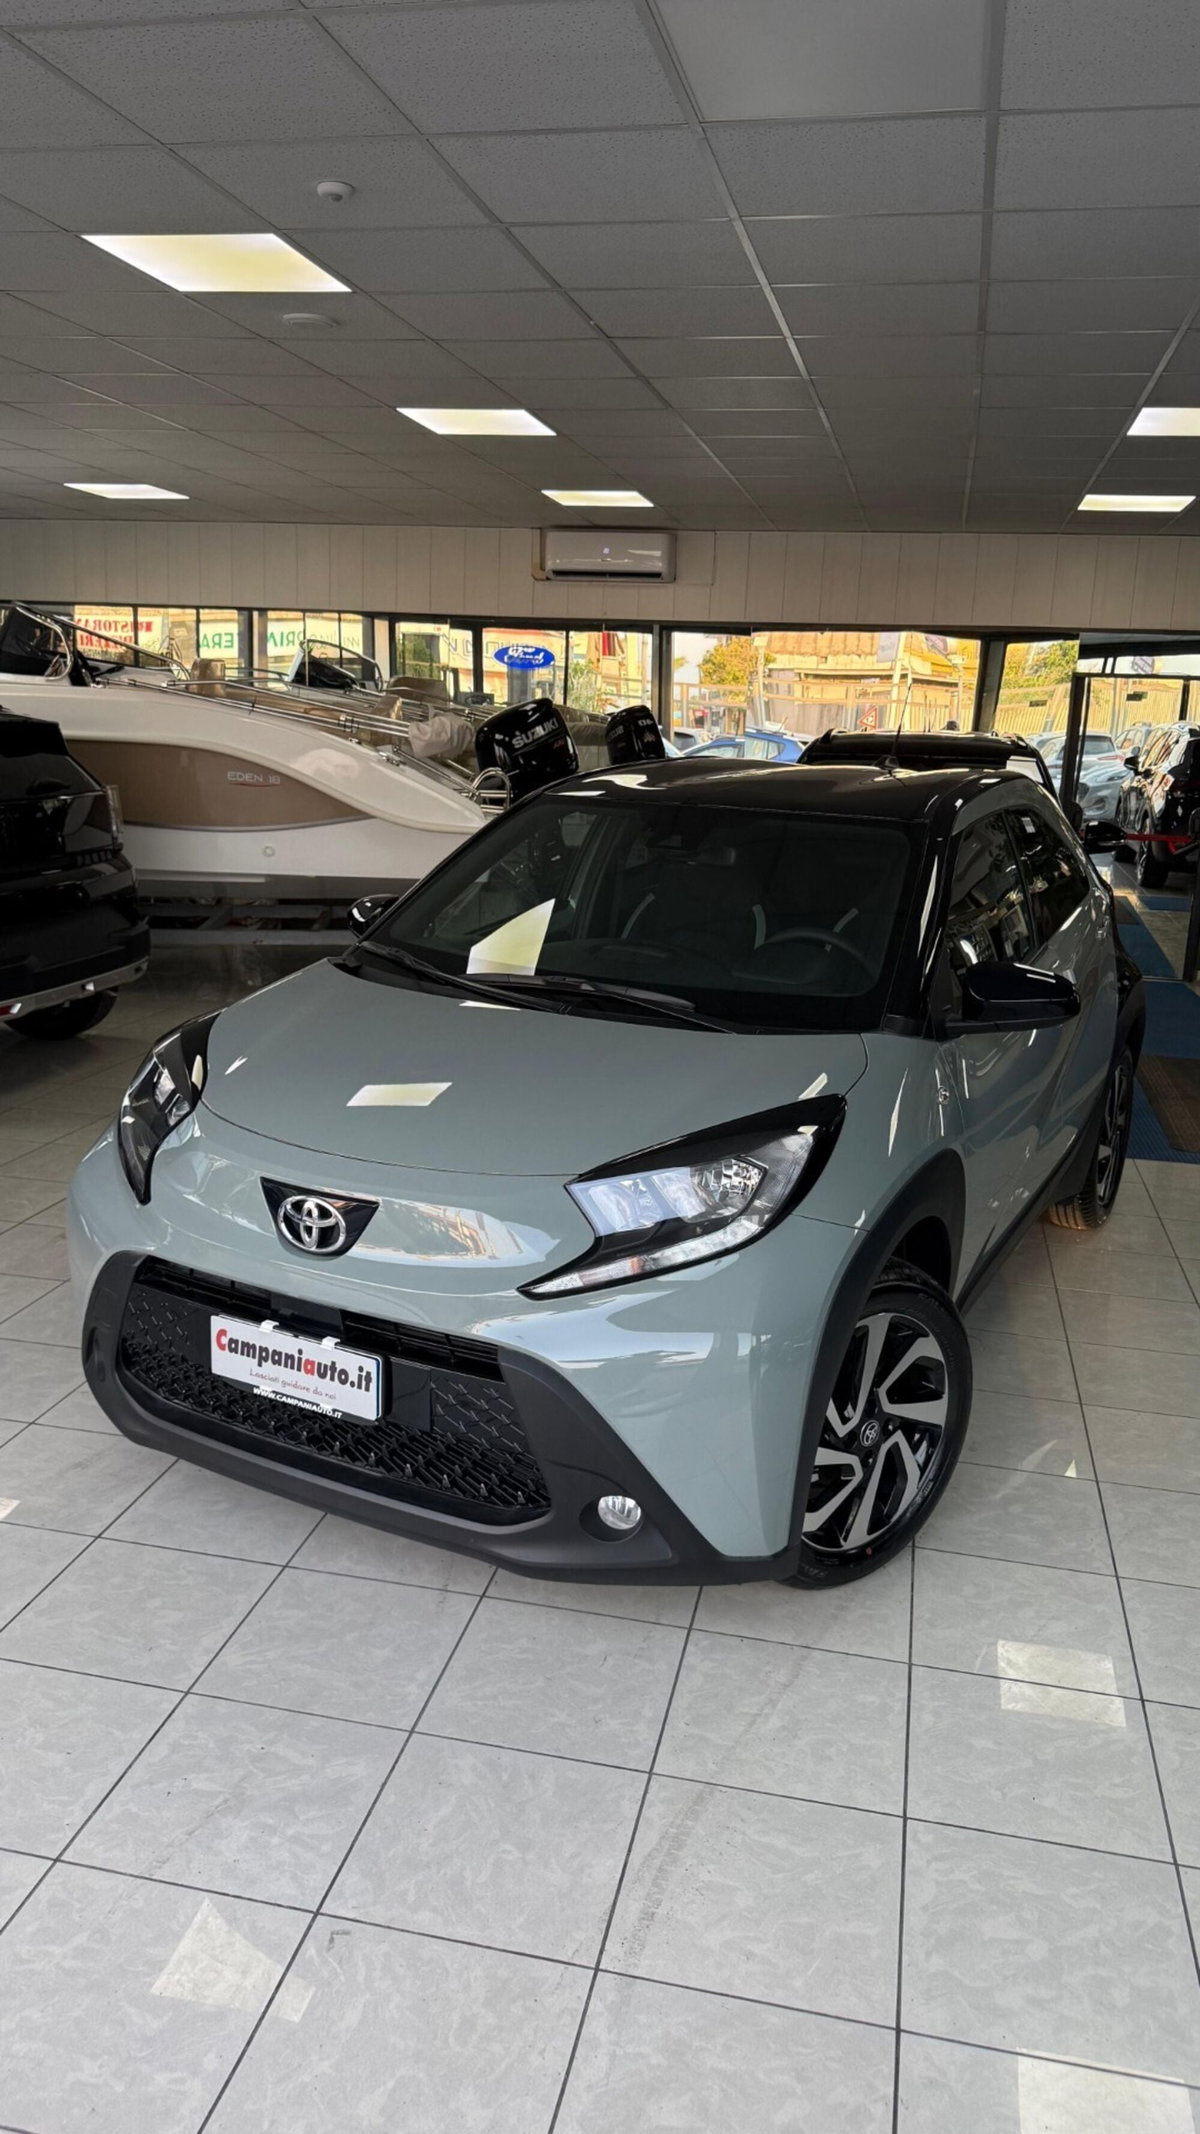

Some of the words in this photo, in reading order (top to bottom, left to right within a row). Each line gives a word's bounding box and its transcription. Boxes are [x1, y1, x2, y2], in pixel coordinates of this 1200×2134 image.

[511, 717, 559, 749] SUZUKI
[226, 770, 264, 783] EDEN
[215, 1328, 373, 1393] Campaniauto.it
[252, 1386, 344, 1420] WWW.CAMPANIAUTO.IT
